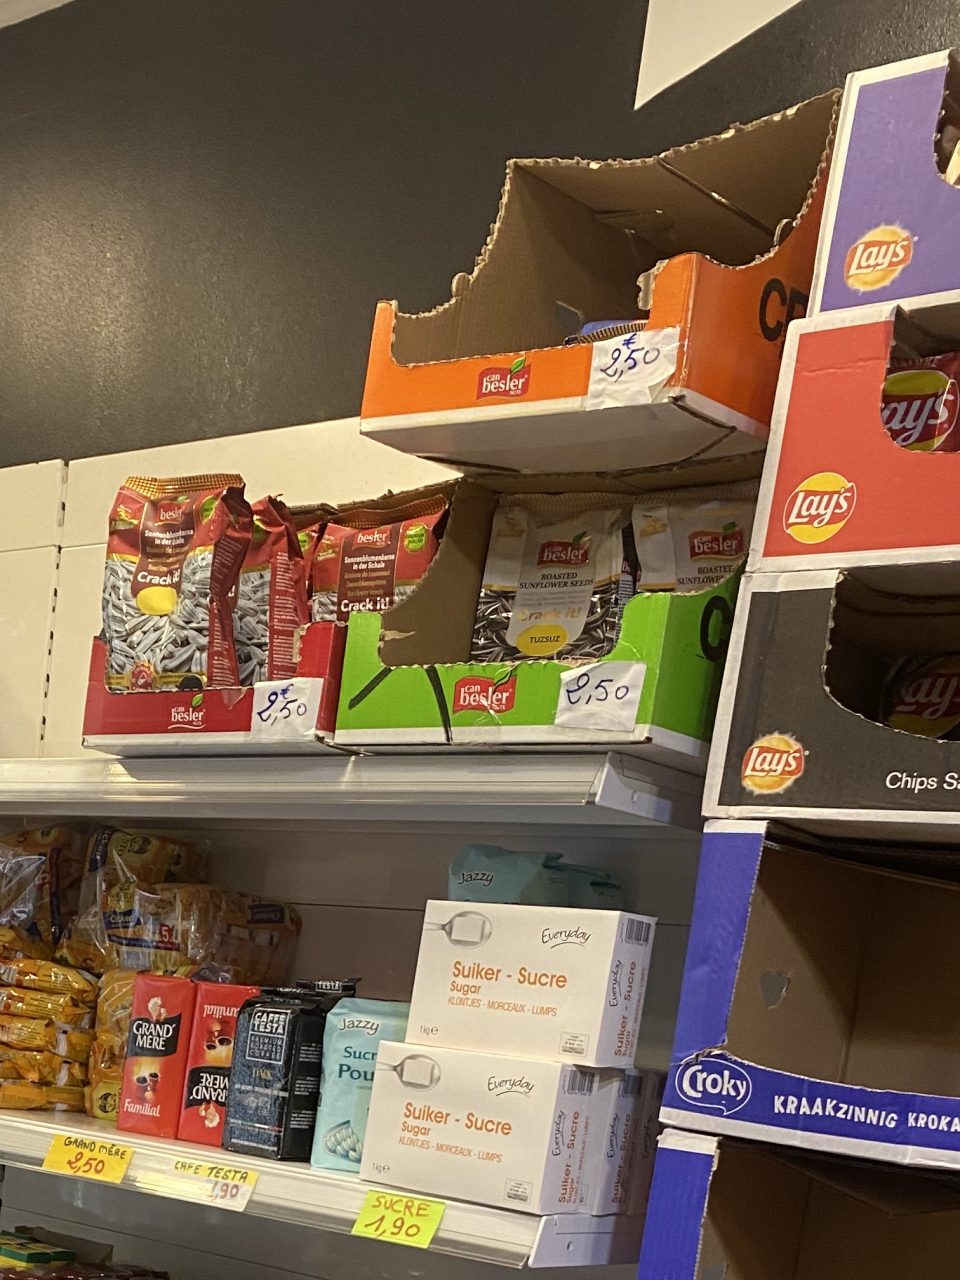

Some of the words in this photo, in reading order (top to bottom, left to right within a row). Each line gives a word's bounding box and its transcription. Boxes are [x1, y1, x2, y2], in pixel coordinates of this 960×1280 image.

[848, 239, 909, 276] Lay's
[600, 344, 661, 384] 2,50
[482, 374, 526, 394] besler
[788, 486, 854, 529] Lay's
[542, 547, 586, 562] besler
[693, 537, 739, 554] besler
[137, 571, 172, 585] Crack
[519, 580, 563, 590] SUNFLOWER
[564, 578, 594, 588] SEEDS
[541, 572, 577, 581] ROASTED
[341, 598, 373, 612] Crack
[529, 635, 561, 644] TUZSUZ
[460, 687, 510, 706] besler
[565, 673, 629, 705] 2,50
[171, 706, 205, 723] besler
[257, 691, 308, 726] 2,50
[744, 747, 801, 777] Lay's
[886, 772, 938, 793] Chips
[458, 871, 494, 887] Jazzy
[541, 927, 592, 944] Everyday
[452, 960, 502, 981] Suiker
[517, 966, 568, 989] Sucre
[623, 962, 637, 1000] Sucre
[450, 980, 481, 996] Sugar
[447, 996, 481, 1009] KLONTJES
[486, 999, 526, 1014] MORCEAUX
[531, 1005, 558, 1017] LUMPS
[133, 1020, 176, 1039] GRAND'
[338, 1017, 381, 1036] Jazzy
[488, 1076, 536, 1094] Everyday
[682, 1065, 747, 1100] Croky
[123, 1098, 161, 1118] Familial
[774, 1095, 898, 1128] KRAAKZINNIG
[401, 1121, 431, 1137] Sugar
[403, 1102, 451, 1125] Suiker
[465, 1112, 513, 1136] Sucre
[551, 1110, 565, 1157] Everyday
[64, 1137, 96, 1153] GRAND
[398, 1135, 431, 1150] KLONTJES
[435, 1143, 473, 1158] MORCEAUX
[477, 1150, 503, 1164] LUMPS
[66, 1151, 105, 1175] 2,50
[559, 1162, 572, 1203] Suiker
[567, 1111, 580, 1150] Sucre
[175, 1161, 200, 1174] CAFE
[207, 1166, 249, 1183] TESTA
[372, 1195, 431, 1218] SUCRE
[364, 1215, 421, 1240] 1,90
